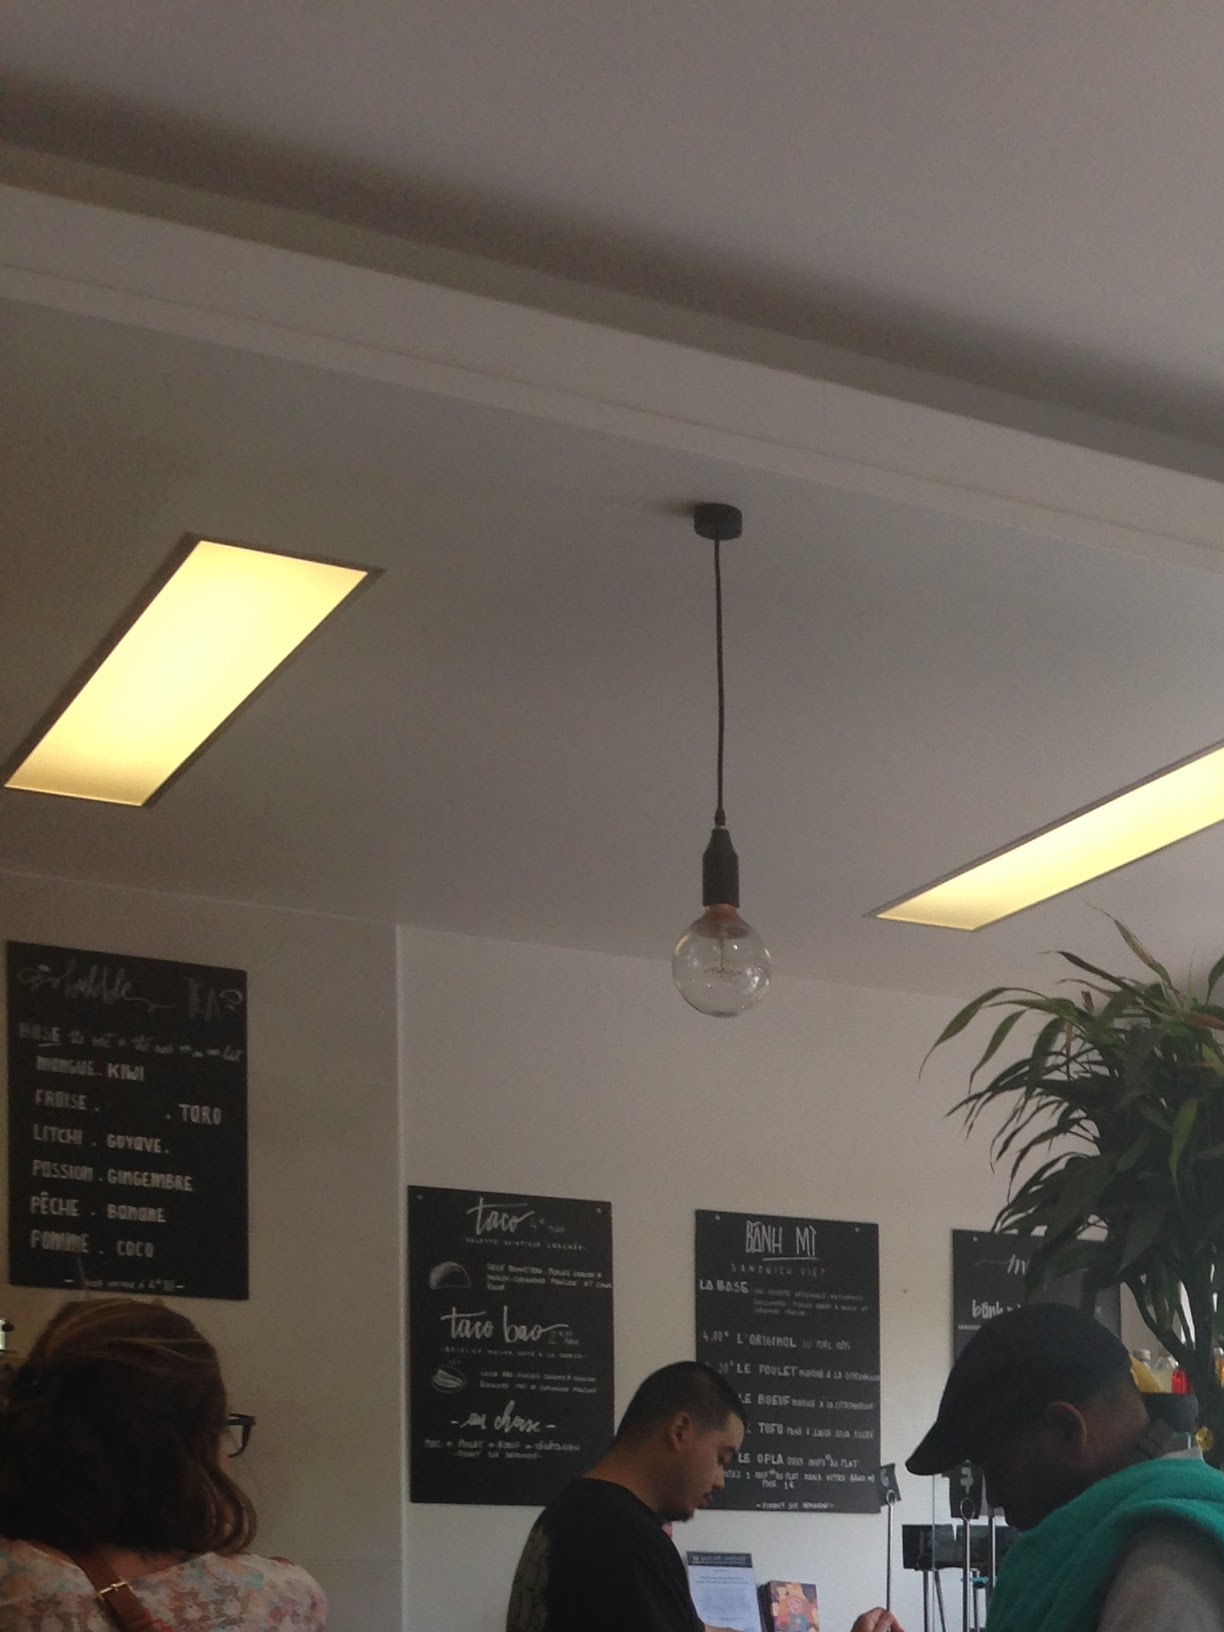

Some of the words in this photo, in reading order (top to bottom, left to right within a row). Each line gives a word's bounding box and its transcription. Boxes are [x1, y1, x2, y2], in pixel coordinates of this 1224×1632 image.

[107, 1062, 145, 1081] KIWI
[33, 1123, 83, 1145] LITCHI
[107, 1167, 193, 1192] GINGEMBRE
[30, 1190, 80, 1217] PÊCHE
[466, 1197, 535, 1235] taco
[116, 1240, 155, 1259] COCO
[699, 1279, 714, 1292] LA
[440, 1306, 494, 1340] taco
[503, 1305, 569, 1344] bao
[736, 1362, 752, 1375] LE
[759, 1364, 799, 1379] POULET
[757, 1393, 791, 1406] BOEUF
[758, 1422, 784, 1436] TOFU
[737, 1452, 751, 1464] LE
[757, 1453, 785, 1466] OPLA
